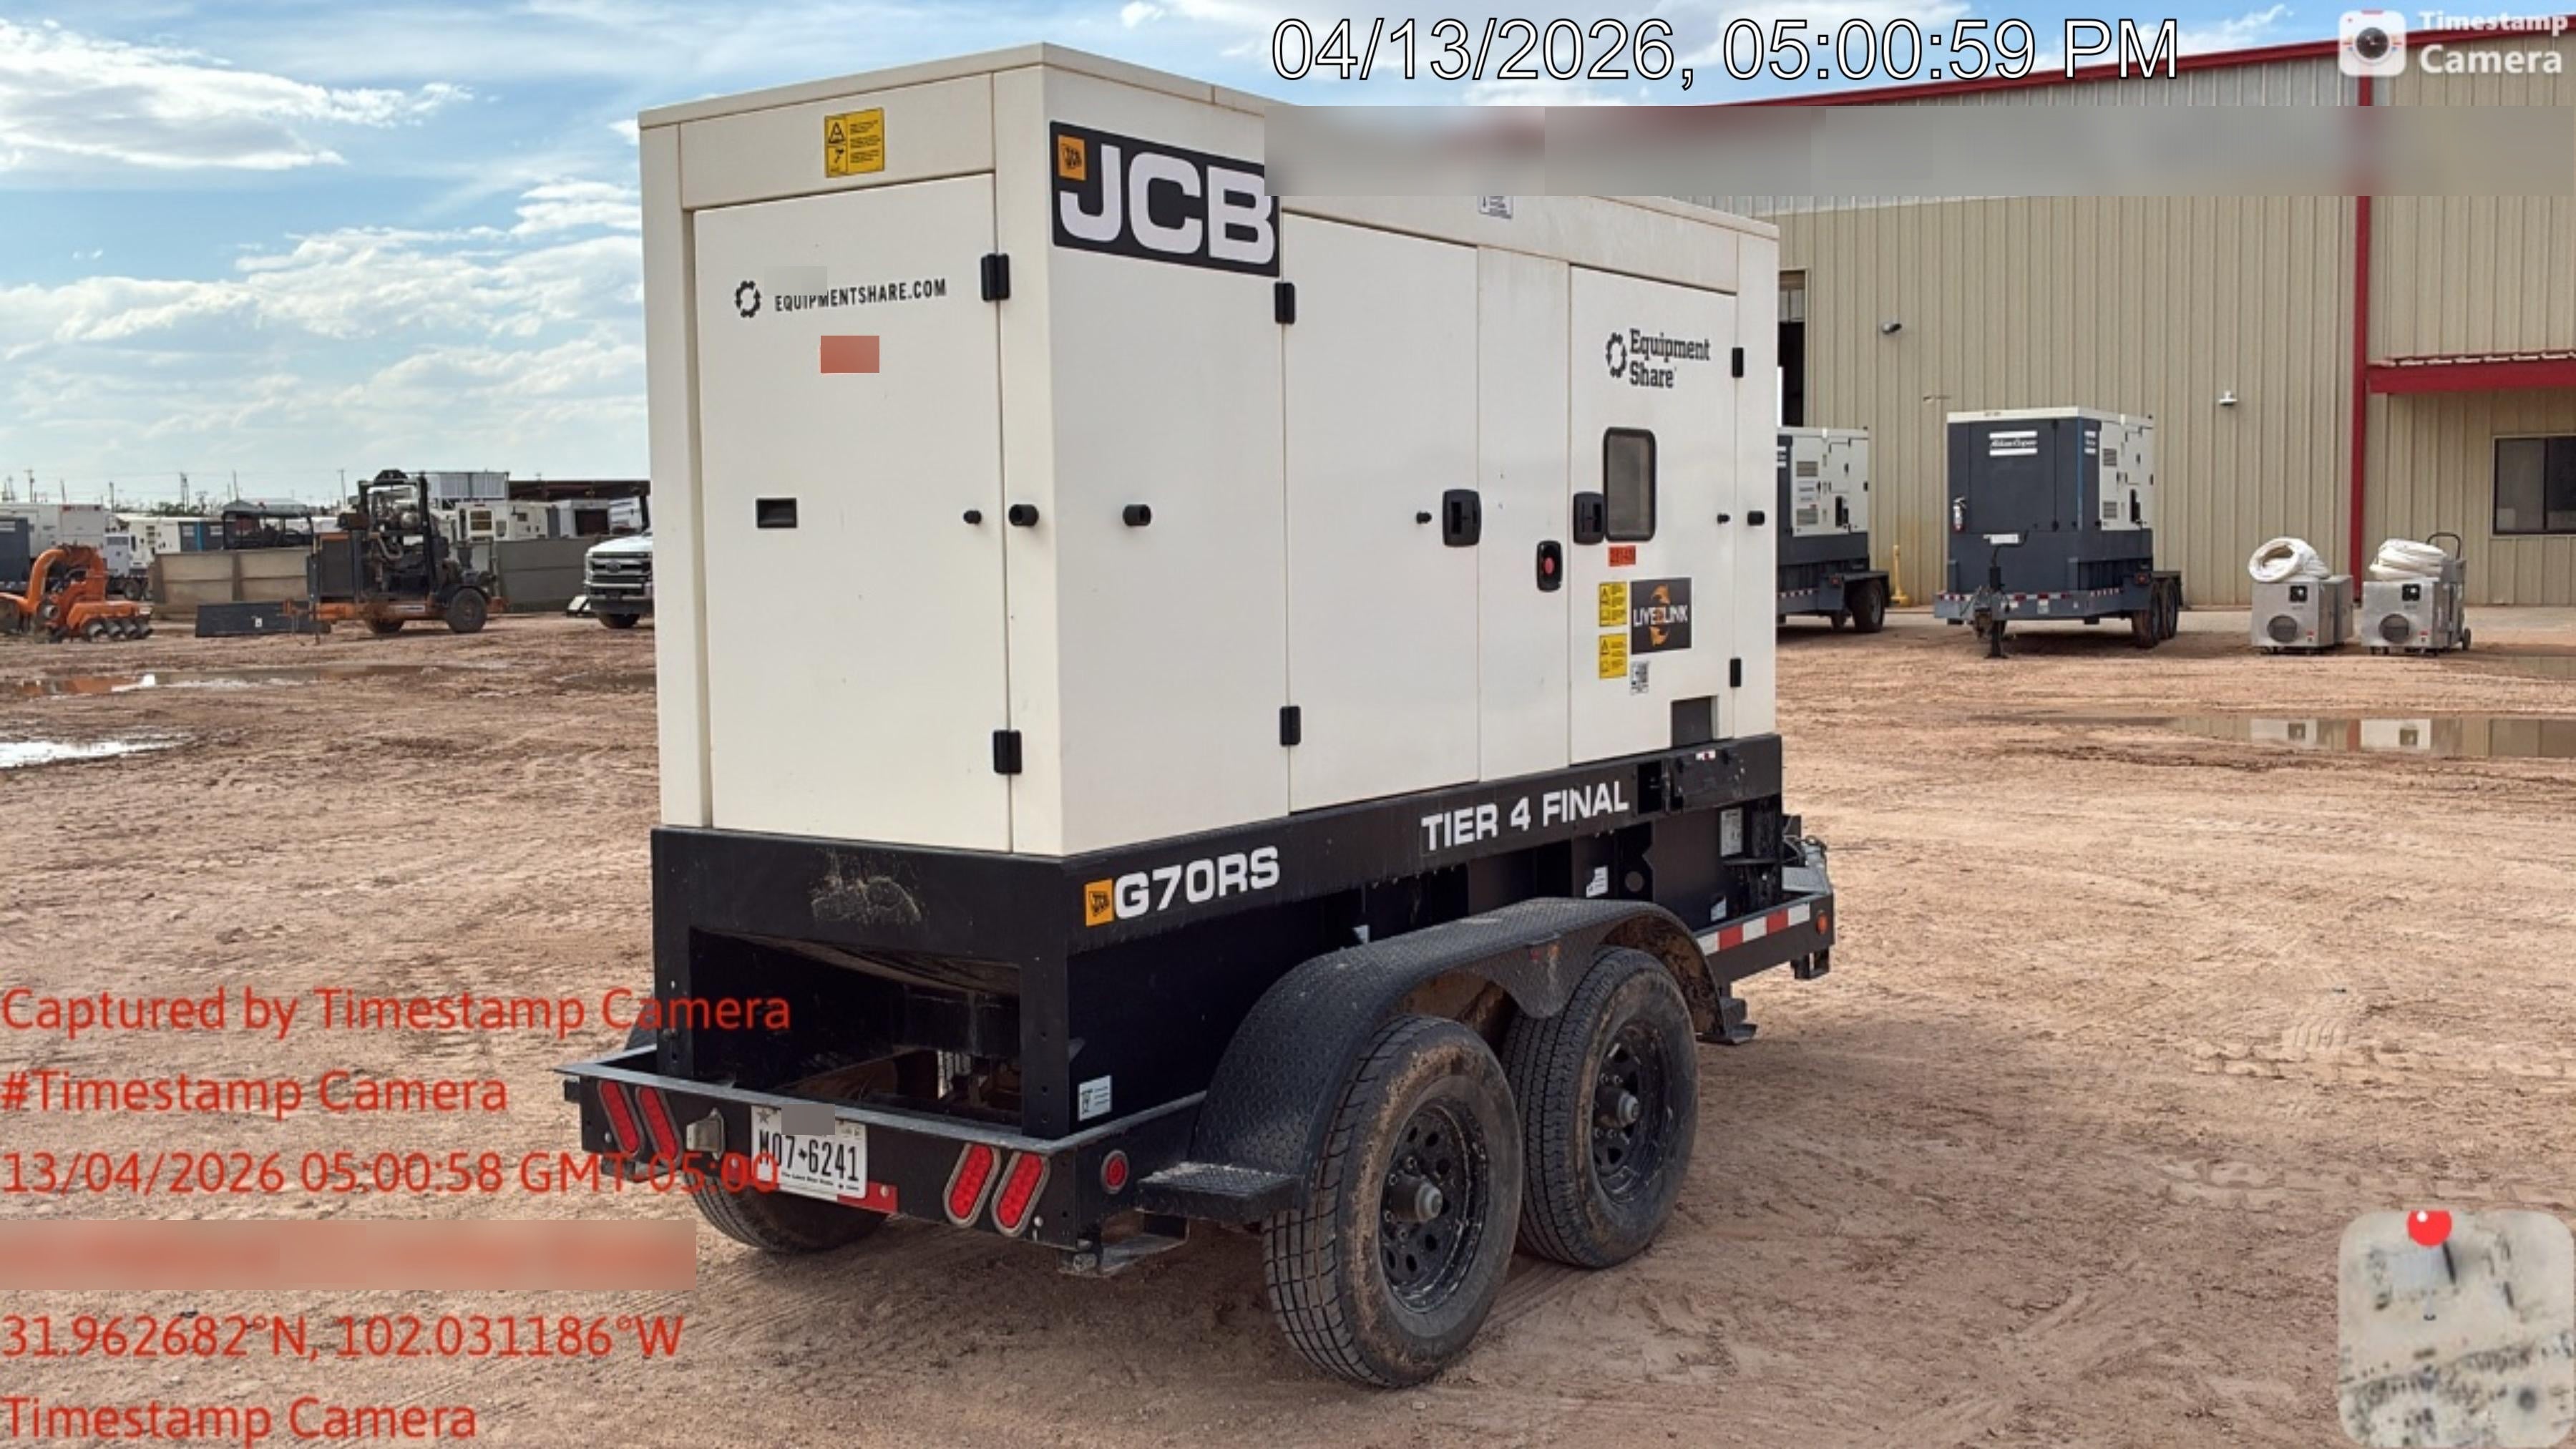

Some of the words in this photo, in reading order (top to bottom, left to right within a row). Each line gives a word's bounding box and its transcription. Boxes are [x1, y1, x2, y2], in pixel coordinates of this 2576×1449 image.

[1059, 142, 1275, 265] JCB
[774, 278, 947, 312] EQUIPMENTSHARE.COM
[1629, 328, 1710, 363] Equipment
[1629, 361, 1674, 389] Share
[1420, 803, 1498, 852] TIER
[1510, 796, 1531, 831] 4
[1543, 781, 1630, 827] FINAL
[1114, 845, 1280, 919] G70RS
